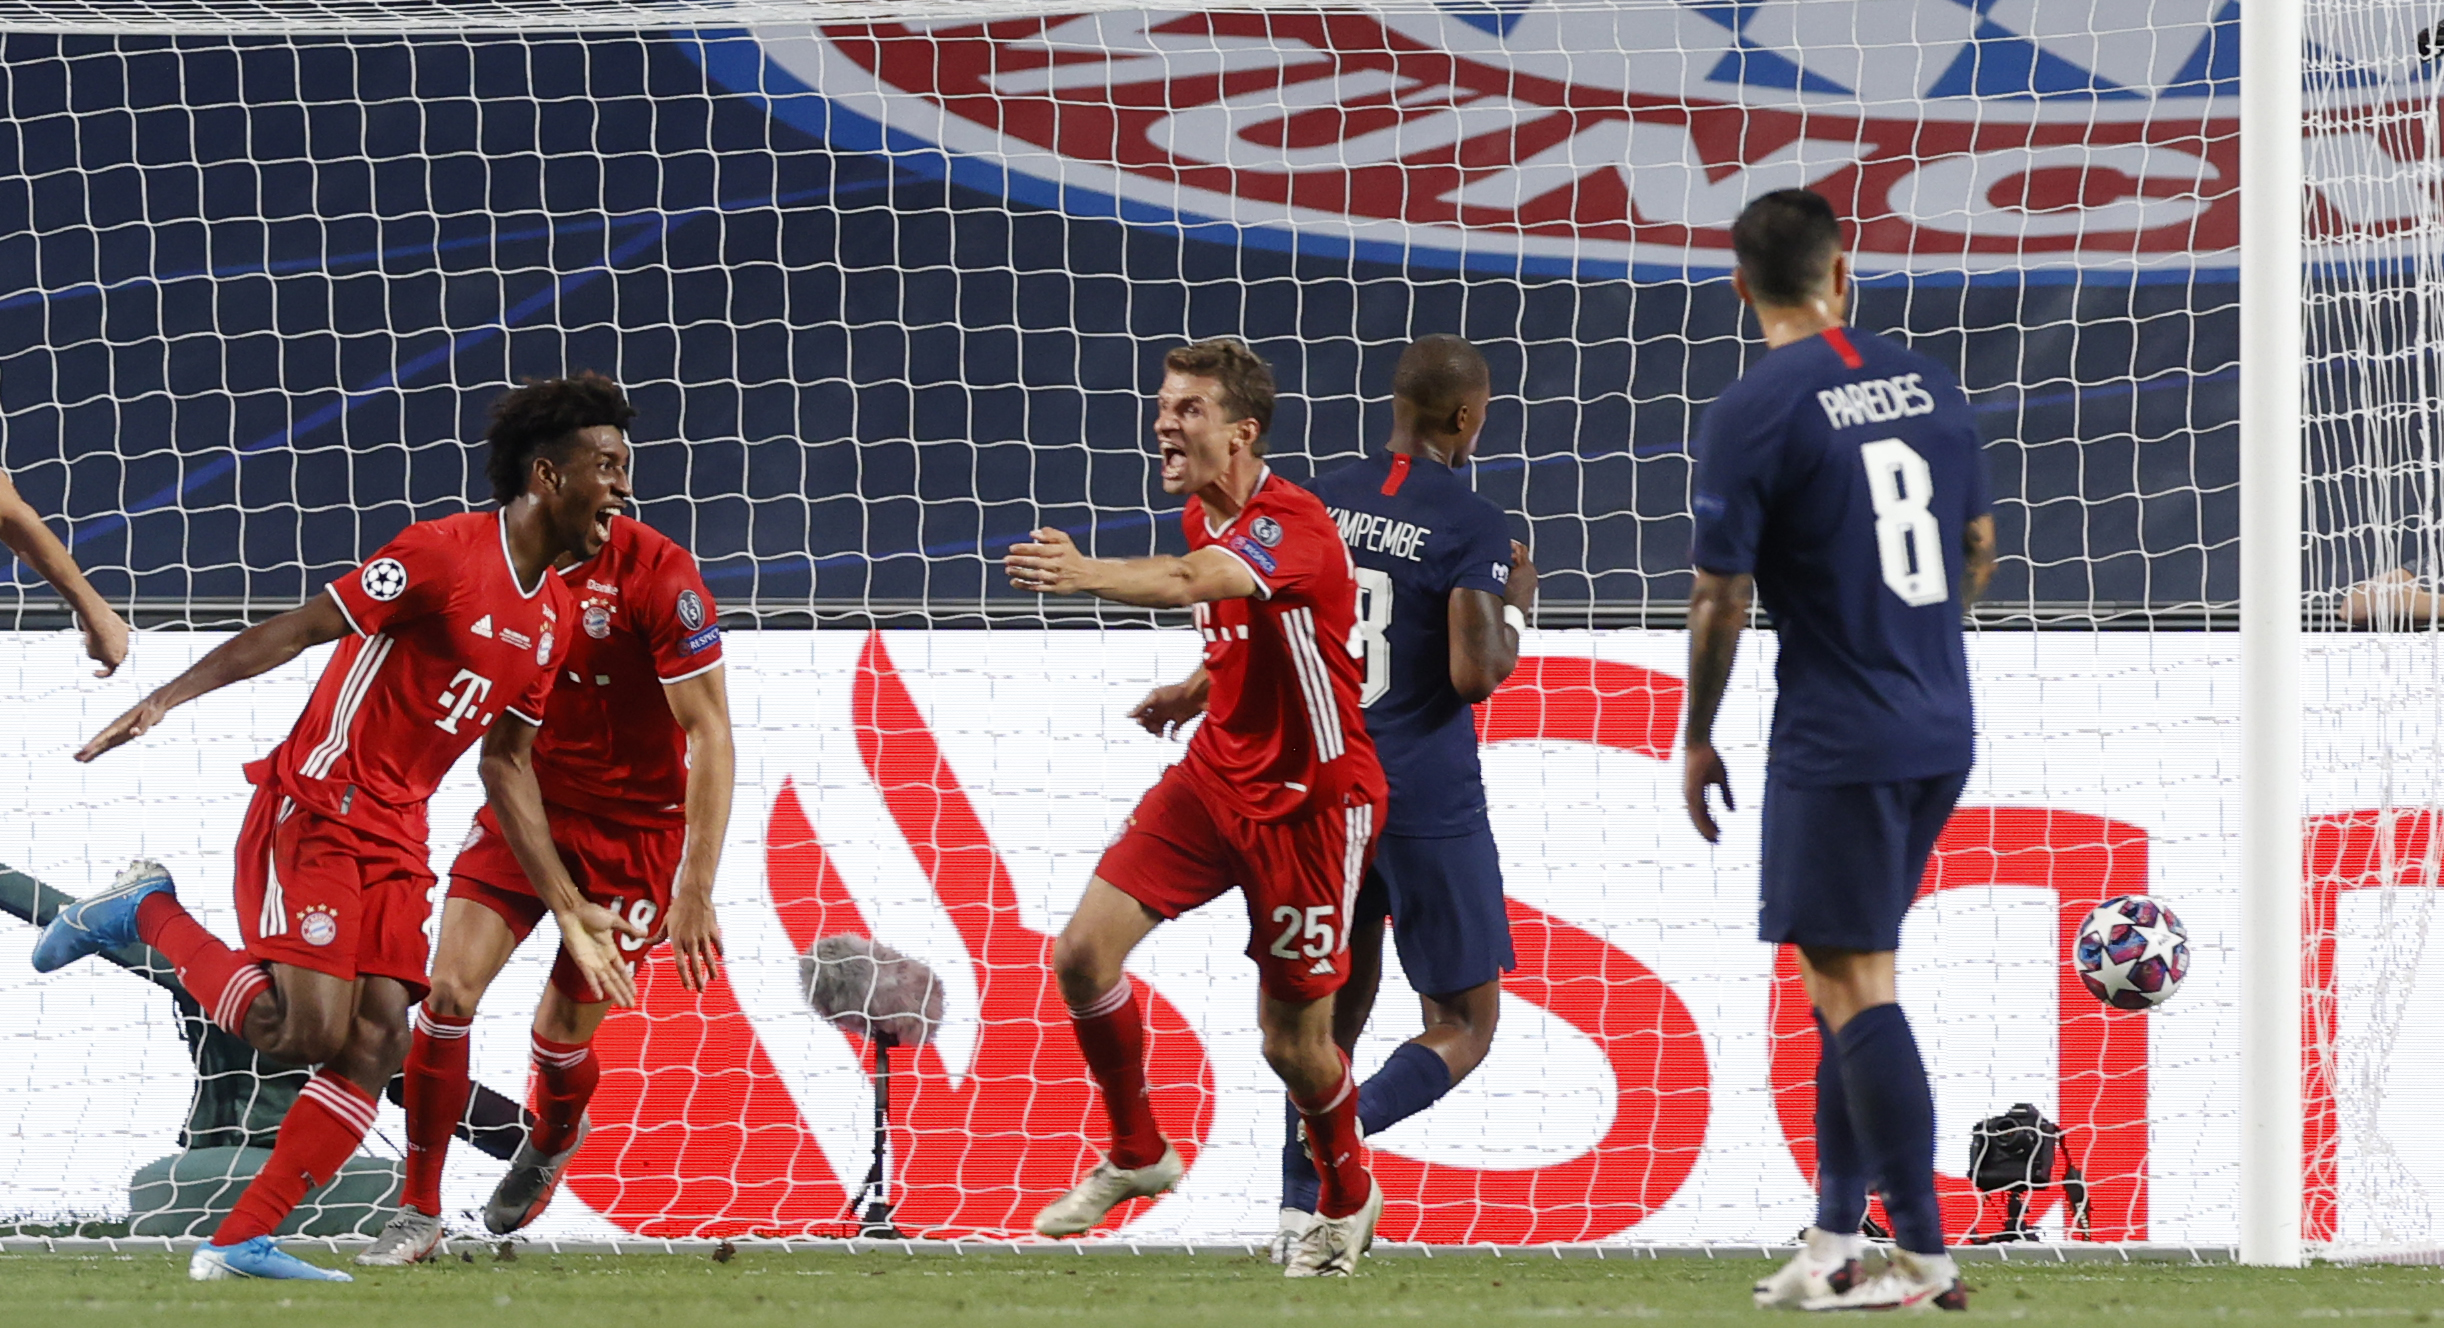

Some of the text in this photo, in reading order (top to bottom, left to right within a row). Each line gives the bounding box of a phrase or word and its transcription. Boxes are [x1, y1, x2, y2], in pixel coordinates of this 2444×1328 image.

[1817, 373, 1935, 430] PAREDES
[1860, 437, 1949, 607] 8
[689, 627, 720, 651] RESPECT
[1270, 905, 1335, 959] 25
